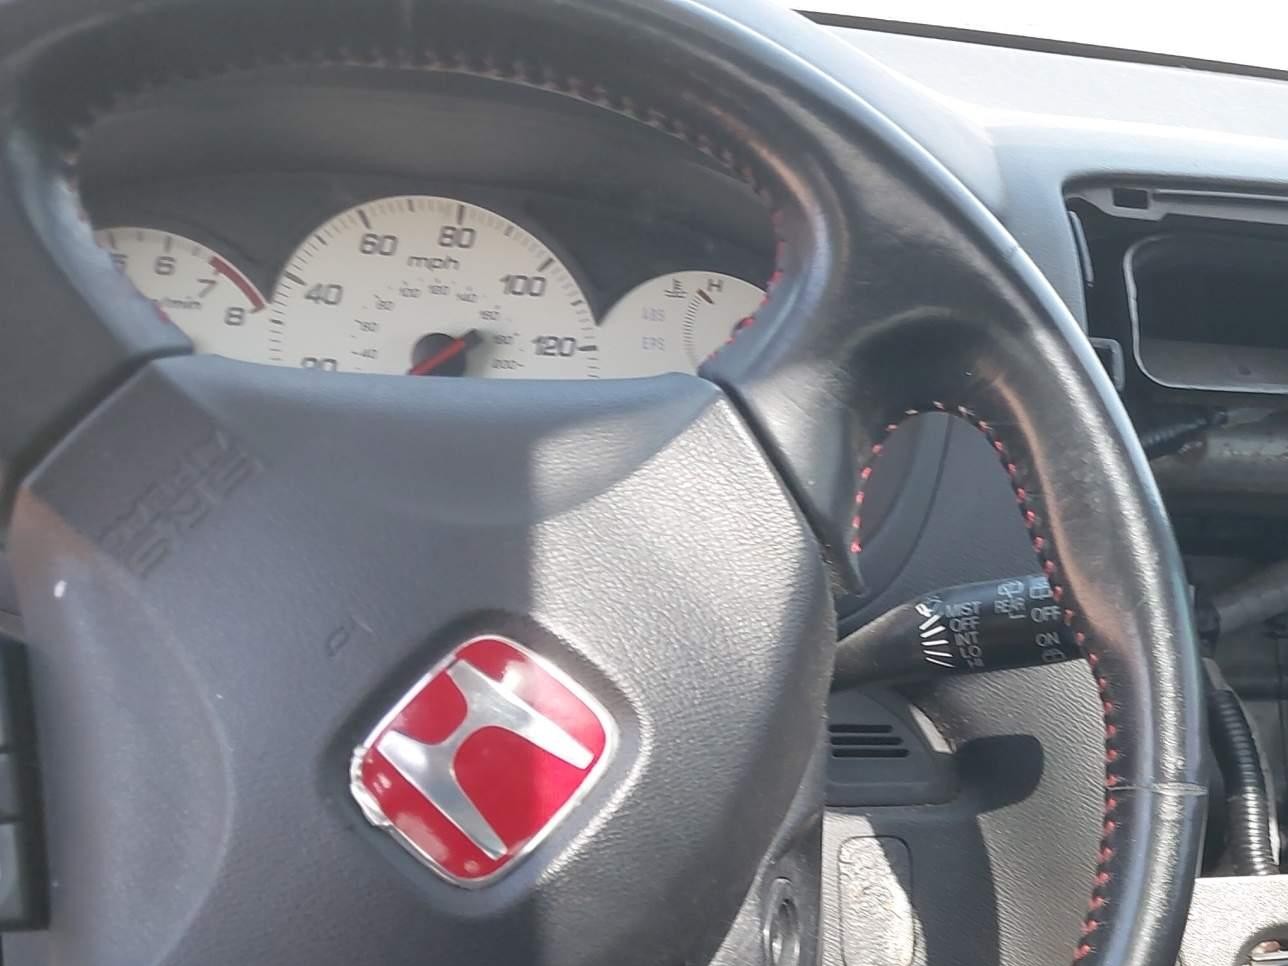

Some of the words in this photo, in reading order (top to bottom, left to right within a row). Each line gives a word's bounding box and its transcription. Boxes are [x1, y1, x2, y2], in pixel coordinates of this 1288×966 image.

[359, 233, 397, 255] 60
[438, 226, 476, 249] 80
[154, 255, 176, 276] 6
[407, 256, 459, 272] mph
[196, 279, 218, 298] 7
[304, 283, 343, 306] 40
[499, 275, 547, 297] 100
[224, 307, 245, 327] 8
[532, 336, 577, 358] 120
[944, 601, 981, 618] MIST
[1030, 605, 1061, 623] OFF
[949, 616, 980, 632] OFF
[954, 631, 980, 647] INT
[1035, 631, 1061, 647] ON
[960, 645, 982, 659] LO
